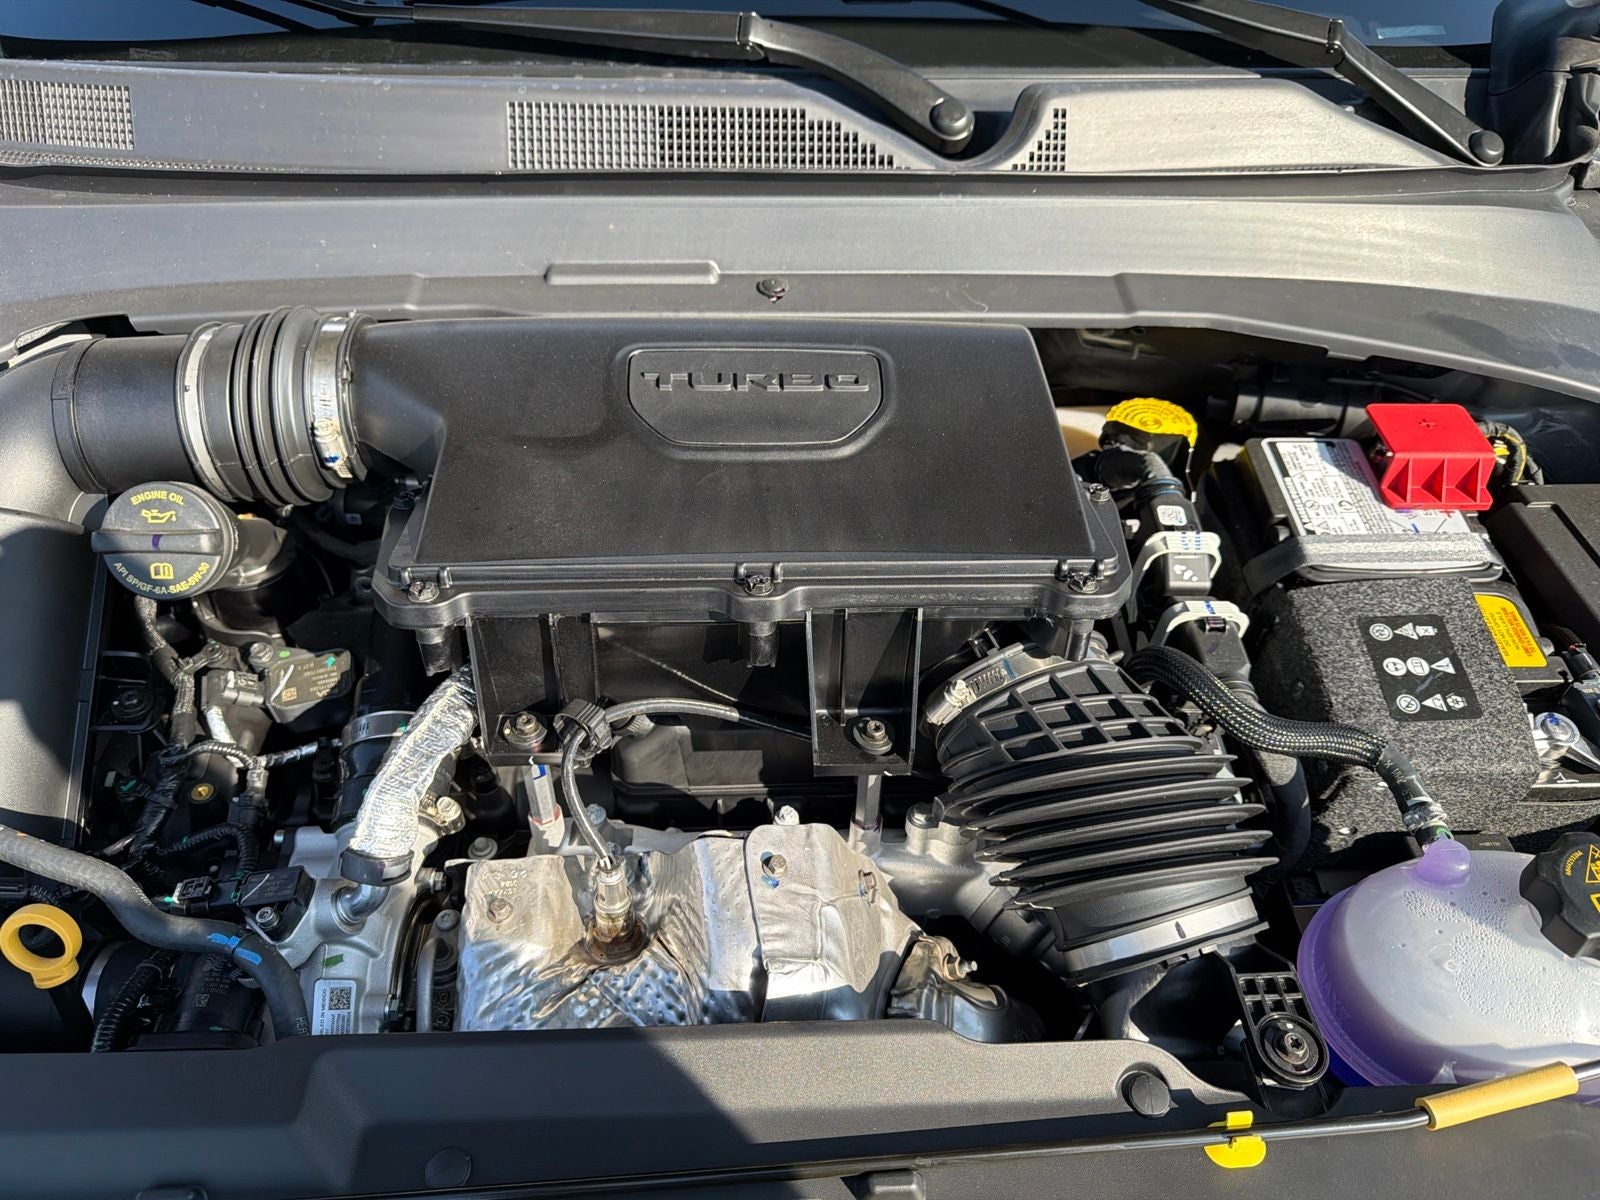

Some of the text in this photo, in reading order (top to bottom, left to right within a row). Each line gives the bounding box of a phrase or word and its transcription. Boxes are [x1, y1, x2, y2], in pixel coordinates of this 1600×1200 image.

[640, 372, 869, 393] TURBO
[130, 490, 184, 506] ENGINE OIL
[113, 562, 129, 577] API
